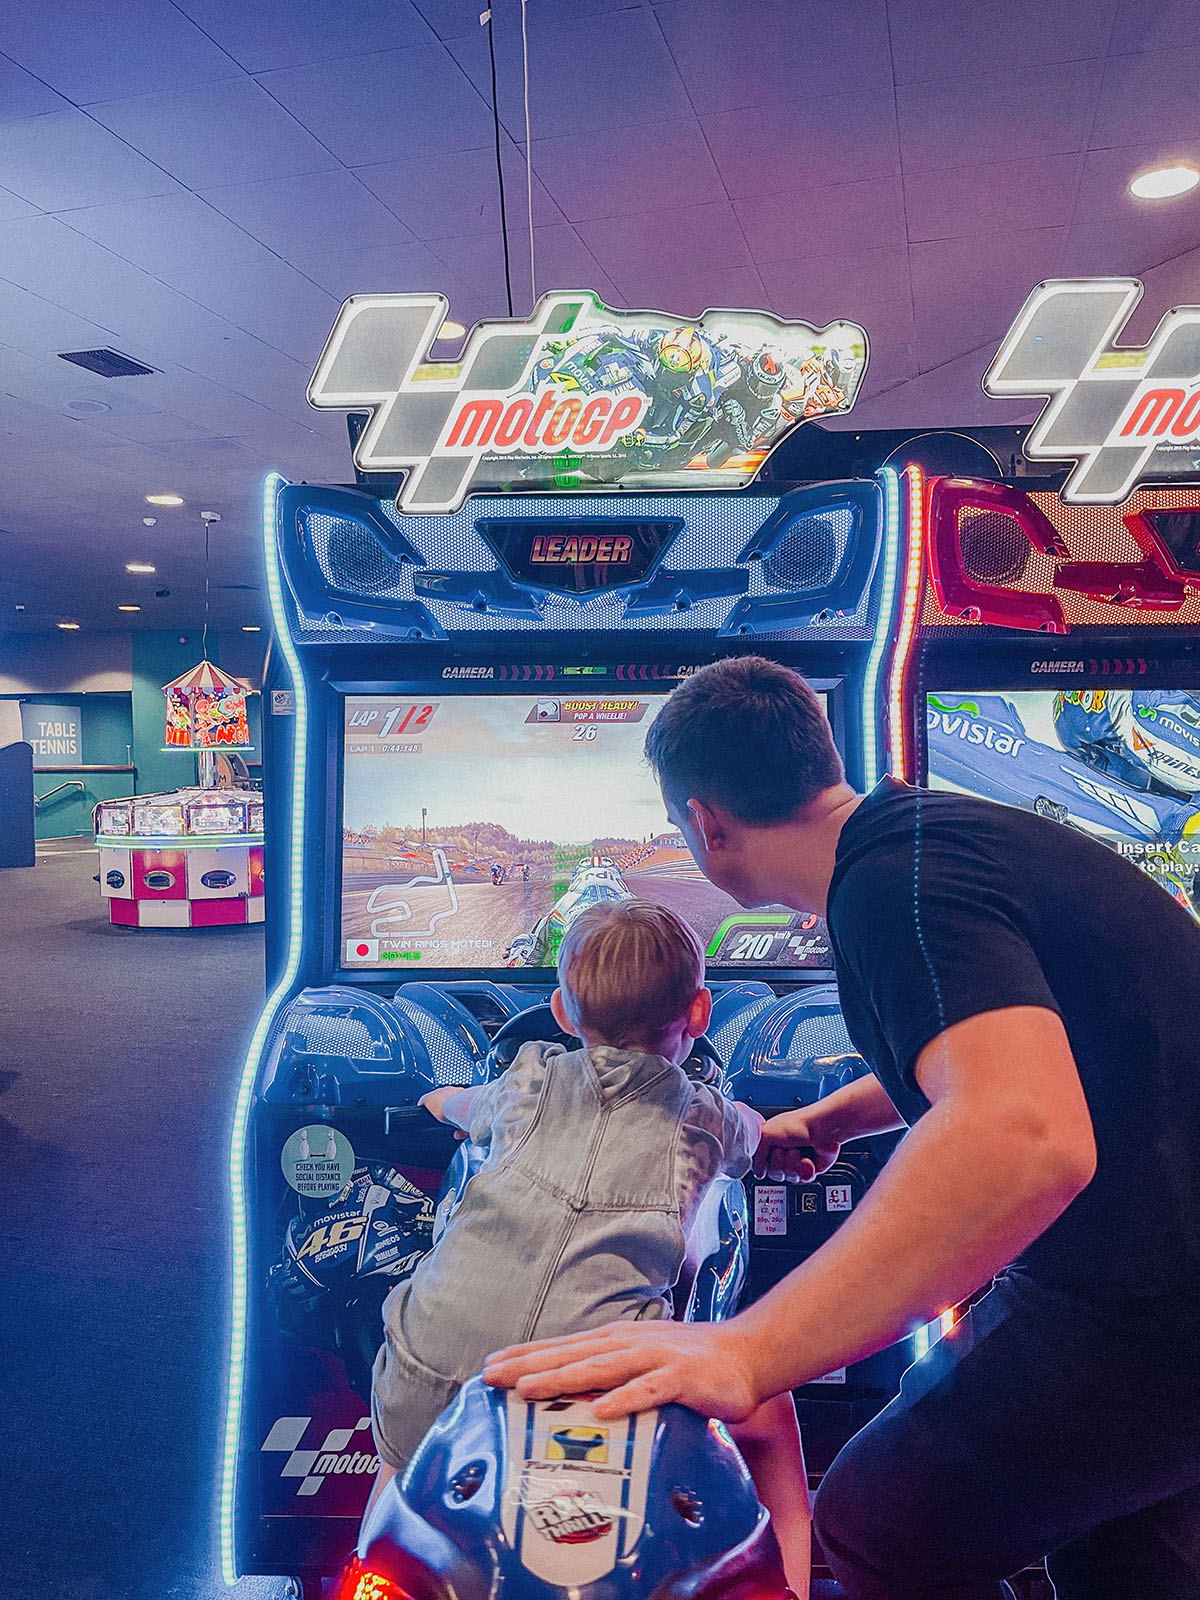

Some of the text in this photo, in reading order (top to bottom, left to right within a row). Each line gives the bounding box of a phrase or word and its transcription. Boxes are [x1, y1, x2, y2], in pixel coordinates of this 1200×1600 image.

[565, 361, 596, 394] movist
[530, 536, 633, 564] LEADER
[441, 666, 494, 679] CAMERA
[1031, 660, 1084, 673] CAMERA
[564, 701, 640, 711] BOOST READY!
[348, 710, 379, 727] LAP
[596, 712, 627, 720] WHEELIE!
[37, 722, 76, 737] TABLE
[572, 724, 598, 741] 26
[927, 709, 1026, 757] ovistar
[1159, 717, 1200, 747] movis
[30, 739, 77, 755] TENNIS
[1117, 839, 1200, 854] Insert Ca
[1161, 861, 1199, 875] play:
[382, 940, 492, 949] TWIN RINGS MOTEGI
[729, 933, 774, 959] 210
[296, 1163, 340, 1171] CHECK YOU HAVE
[295, 1173, 341, 1181] SOCIAL DISTANCE
[297, 1183, 340, 1191] BEFORE PLAYING
[828, 1188, 849, 1204] £1
[314, 1210, 361, 1227] movistar
[297, 1216, 369, 1261] 46
